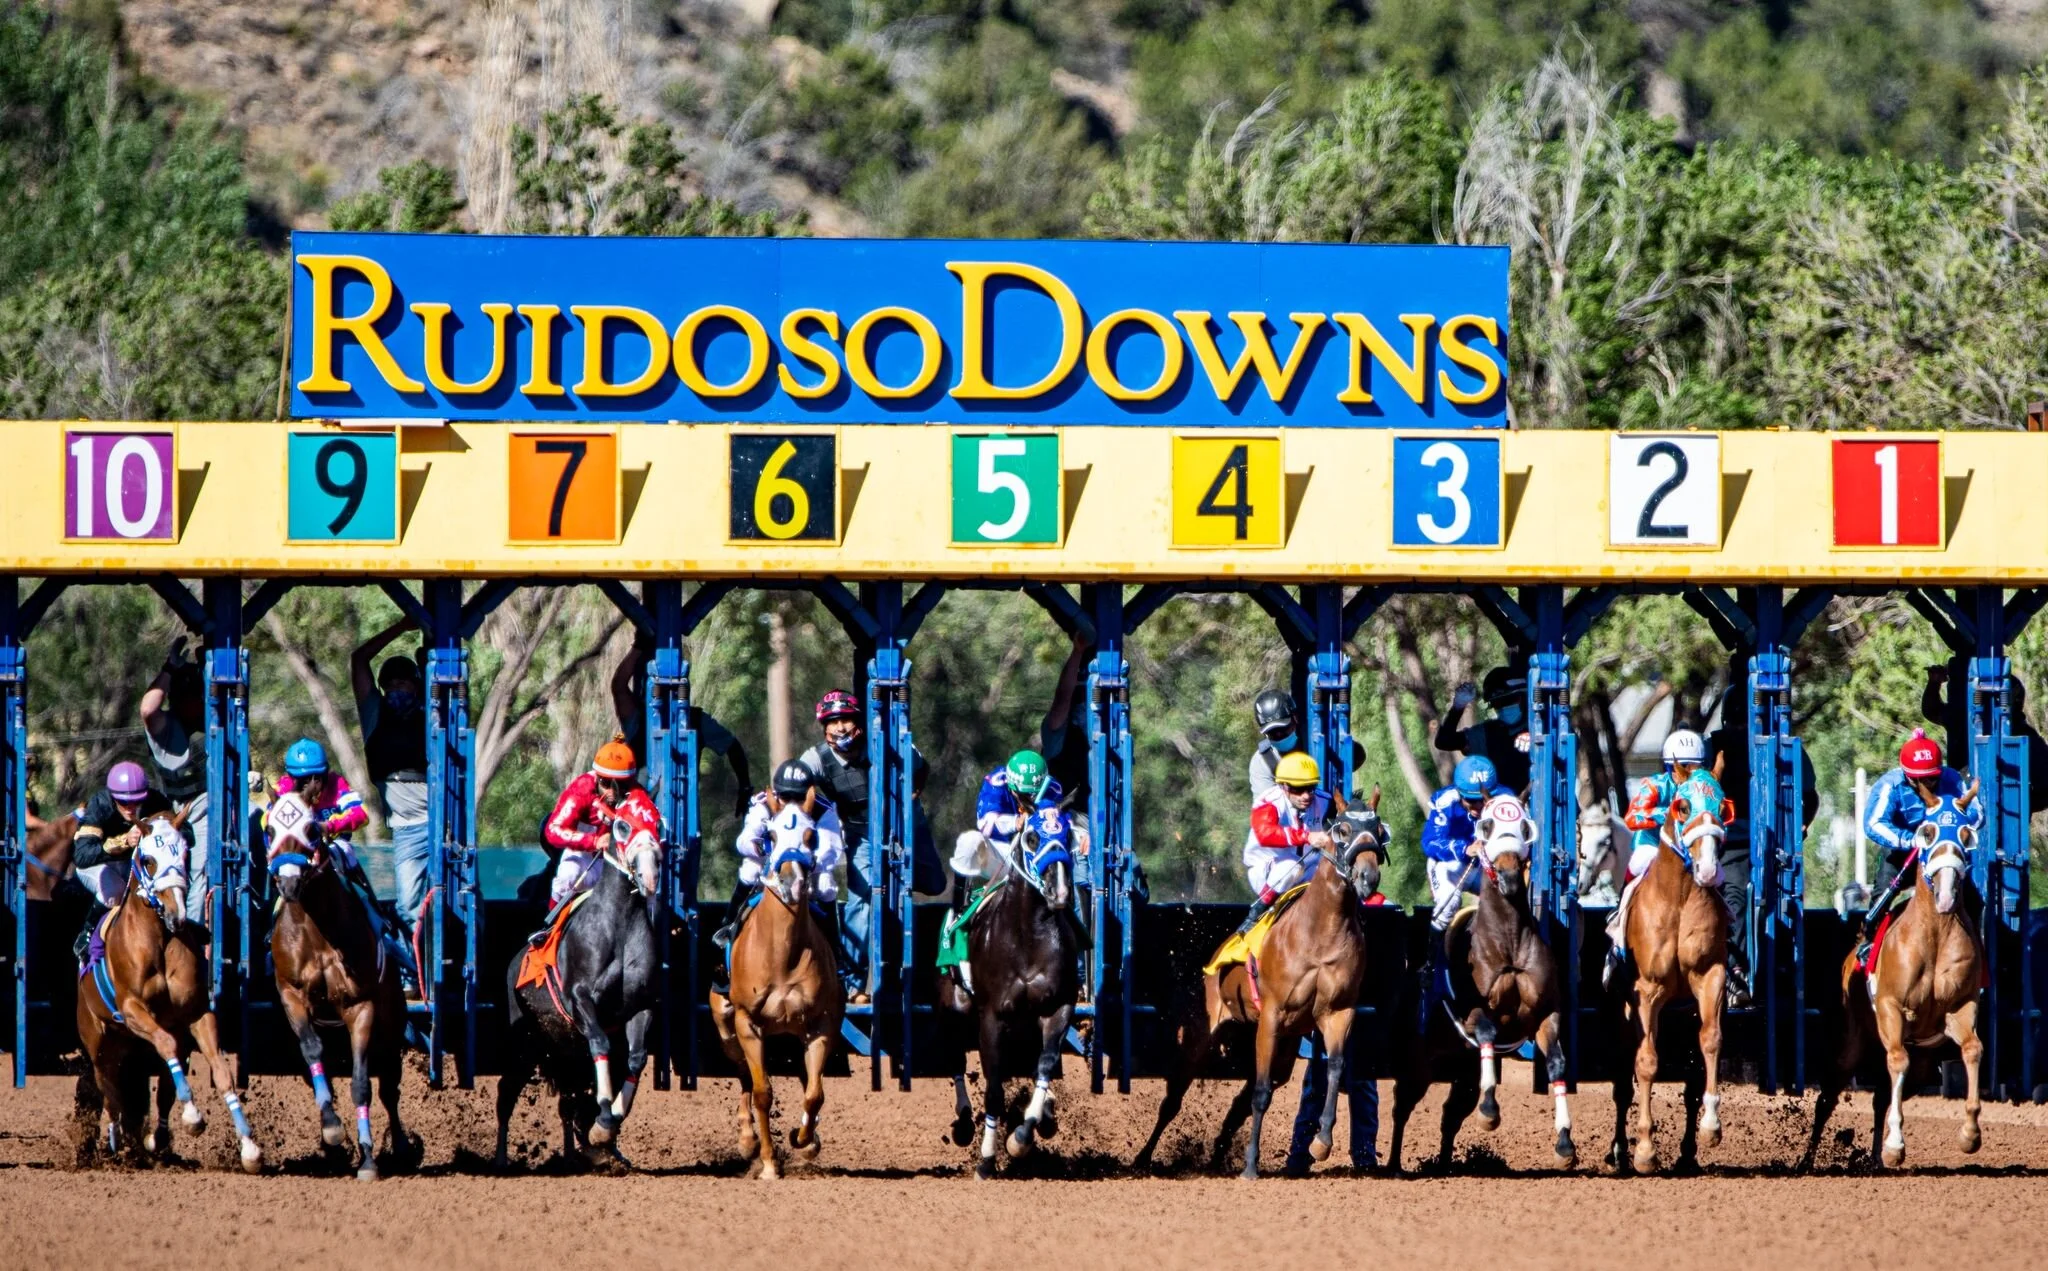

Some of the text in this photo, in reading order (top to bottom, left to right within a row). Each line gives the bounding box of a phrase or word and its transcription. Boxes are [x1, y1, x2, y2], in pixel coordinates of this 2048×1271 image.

[70, 435, 164, 539] 10
[314, 438, 368, 537] 9
[534, 440, 588, 538] 7
[753, 439, 810, 540] 6
[976, 438, 1032, 540] 5
[1195, 444, 1254, 541] 4
[1416, 441, 1472, 545] 3
[1635, 440, 1689, 538] 2
[1874, 444, 1898, 545] 1
[784, 813, 798, 830] J
